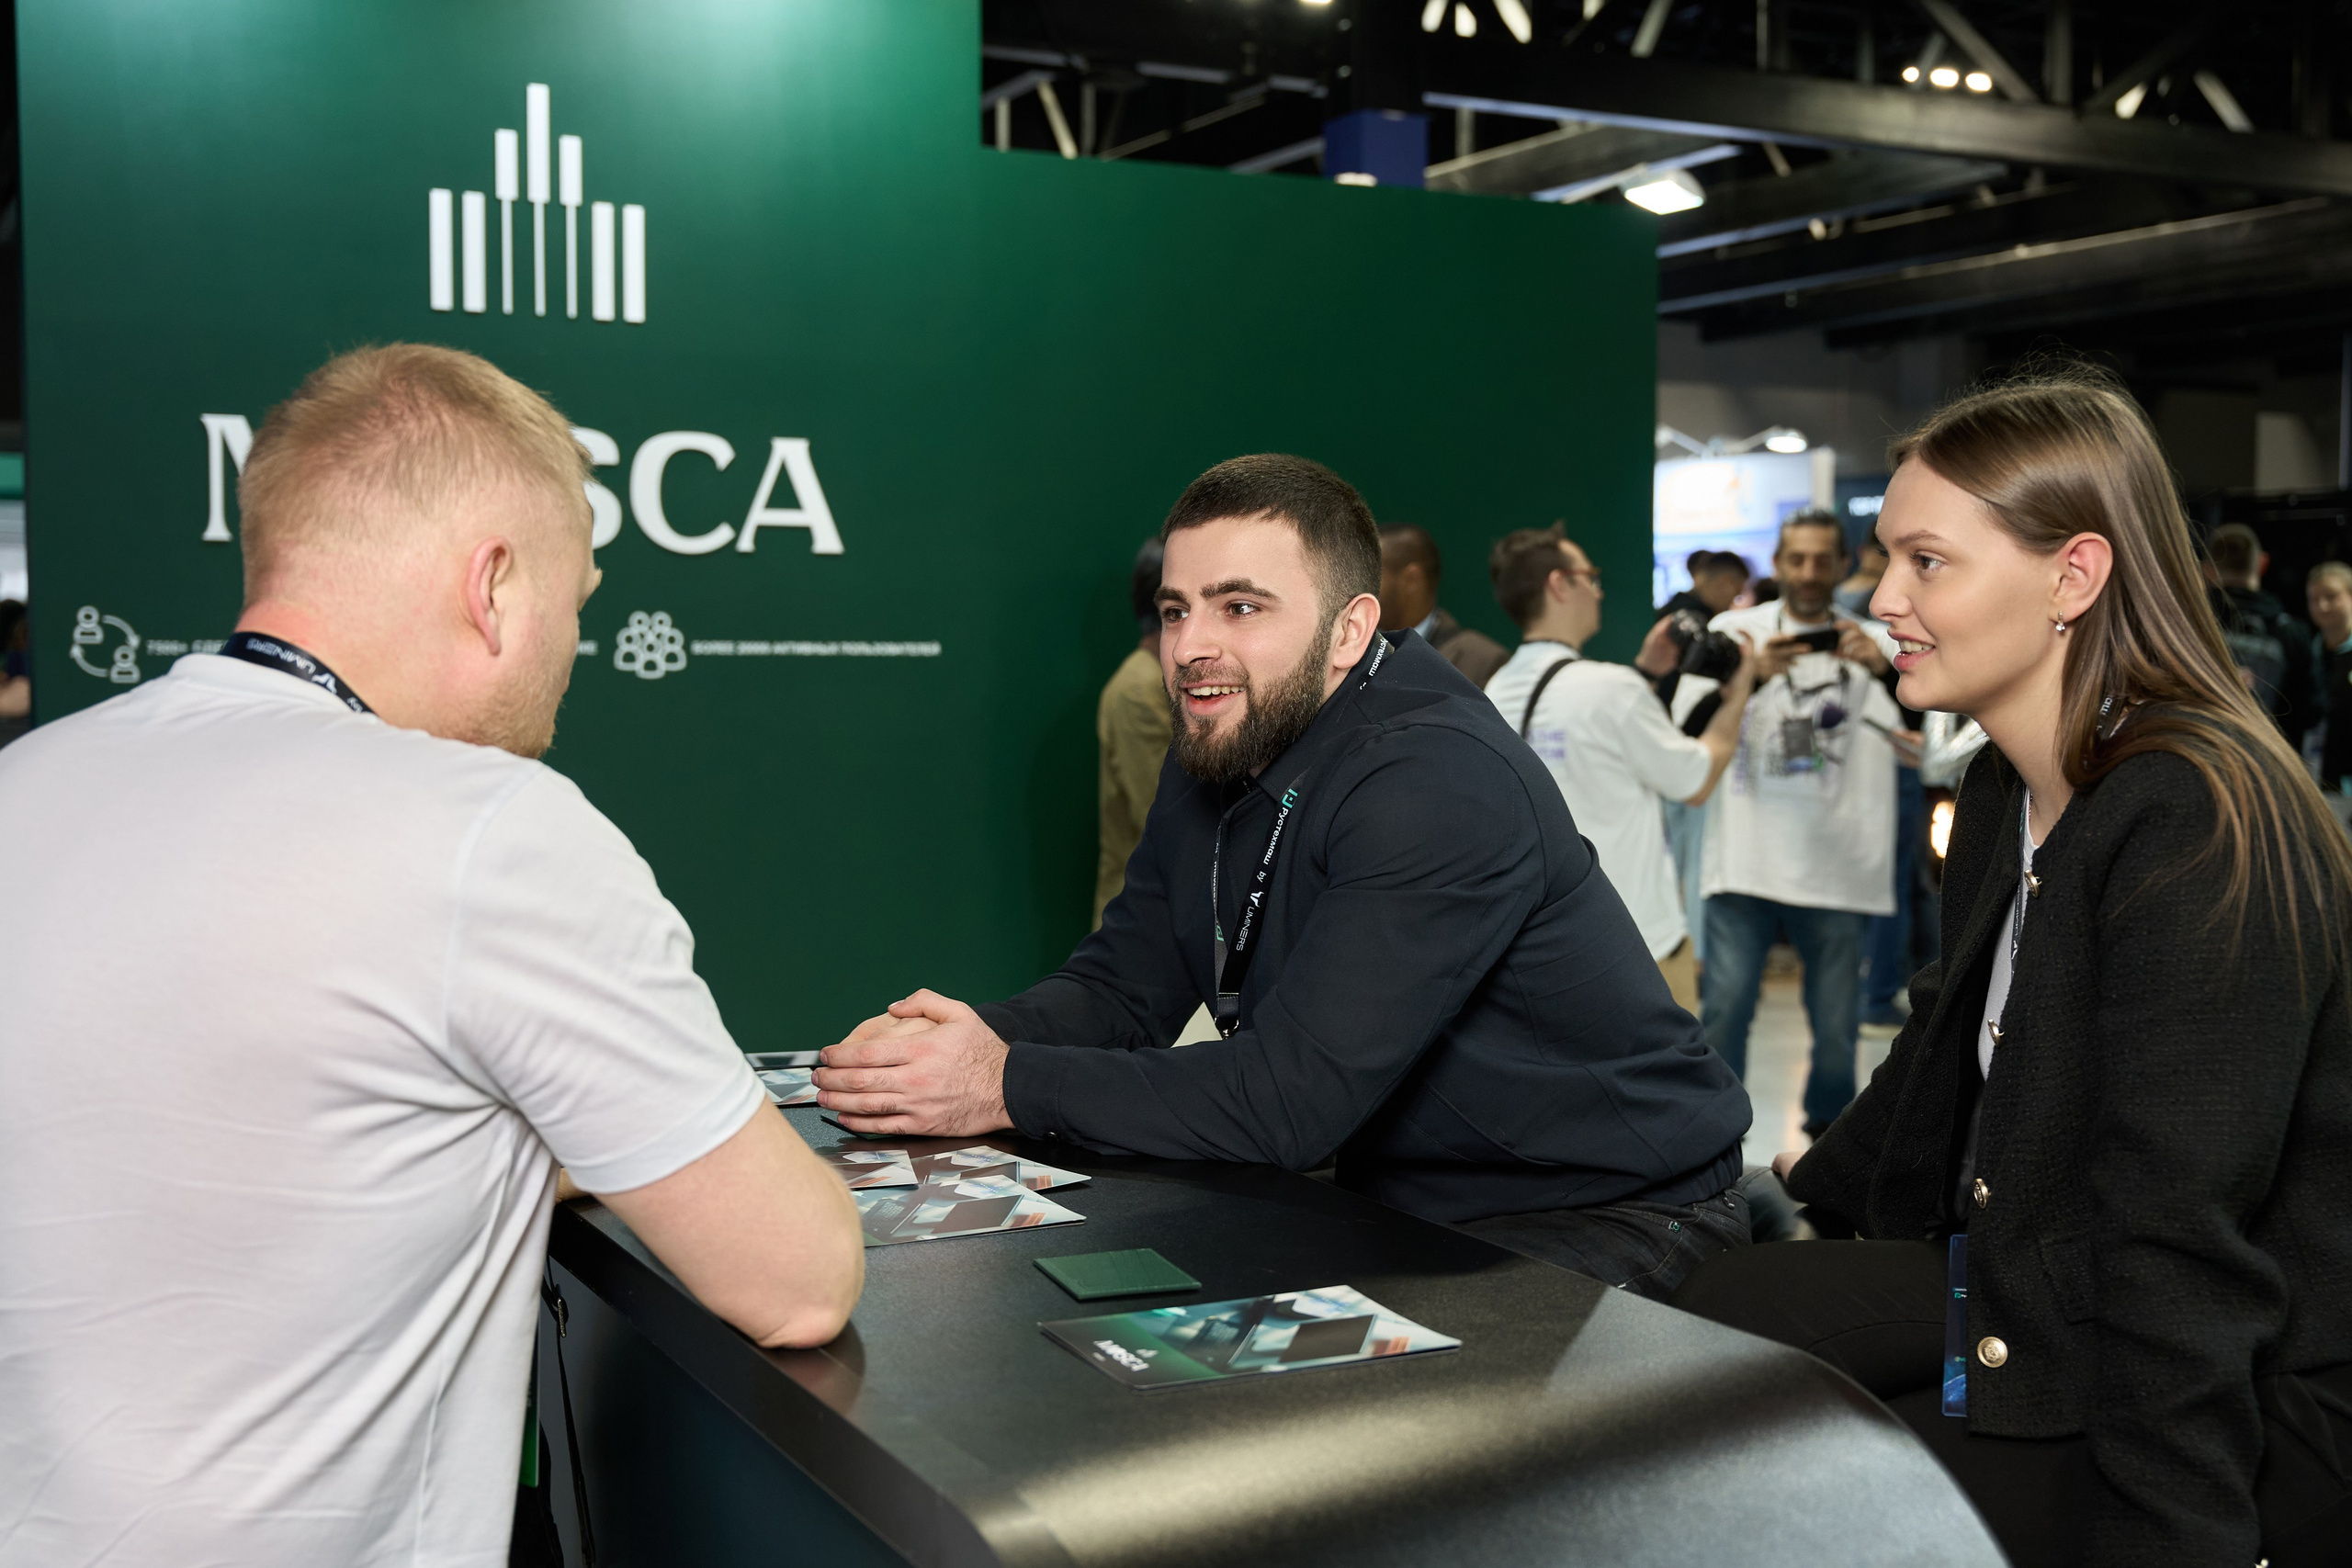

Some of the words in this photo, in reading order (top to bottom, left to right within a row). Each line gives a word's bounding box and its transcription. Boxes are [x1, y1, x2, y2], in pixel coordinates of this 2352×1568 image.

[200, 413, 845, 556] SCA
[246, 637, 317, 674] UMINERS
[1368, 636, 1388, 677] устехмаш
[1257, 871, 1267, 884] by
[1236, 906, 1255, 952] UMINERS
